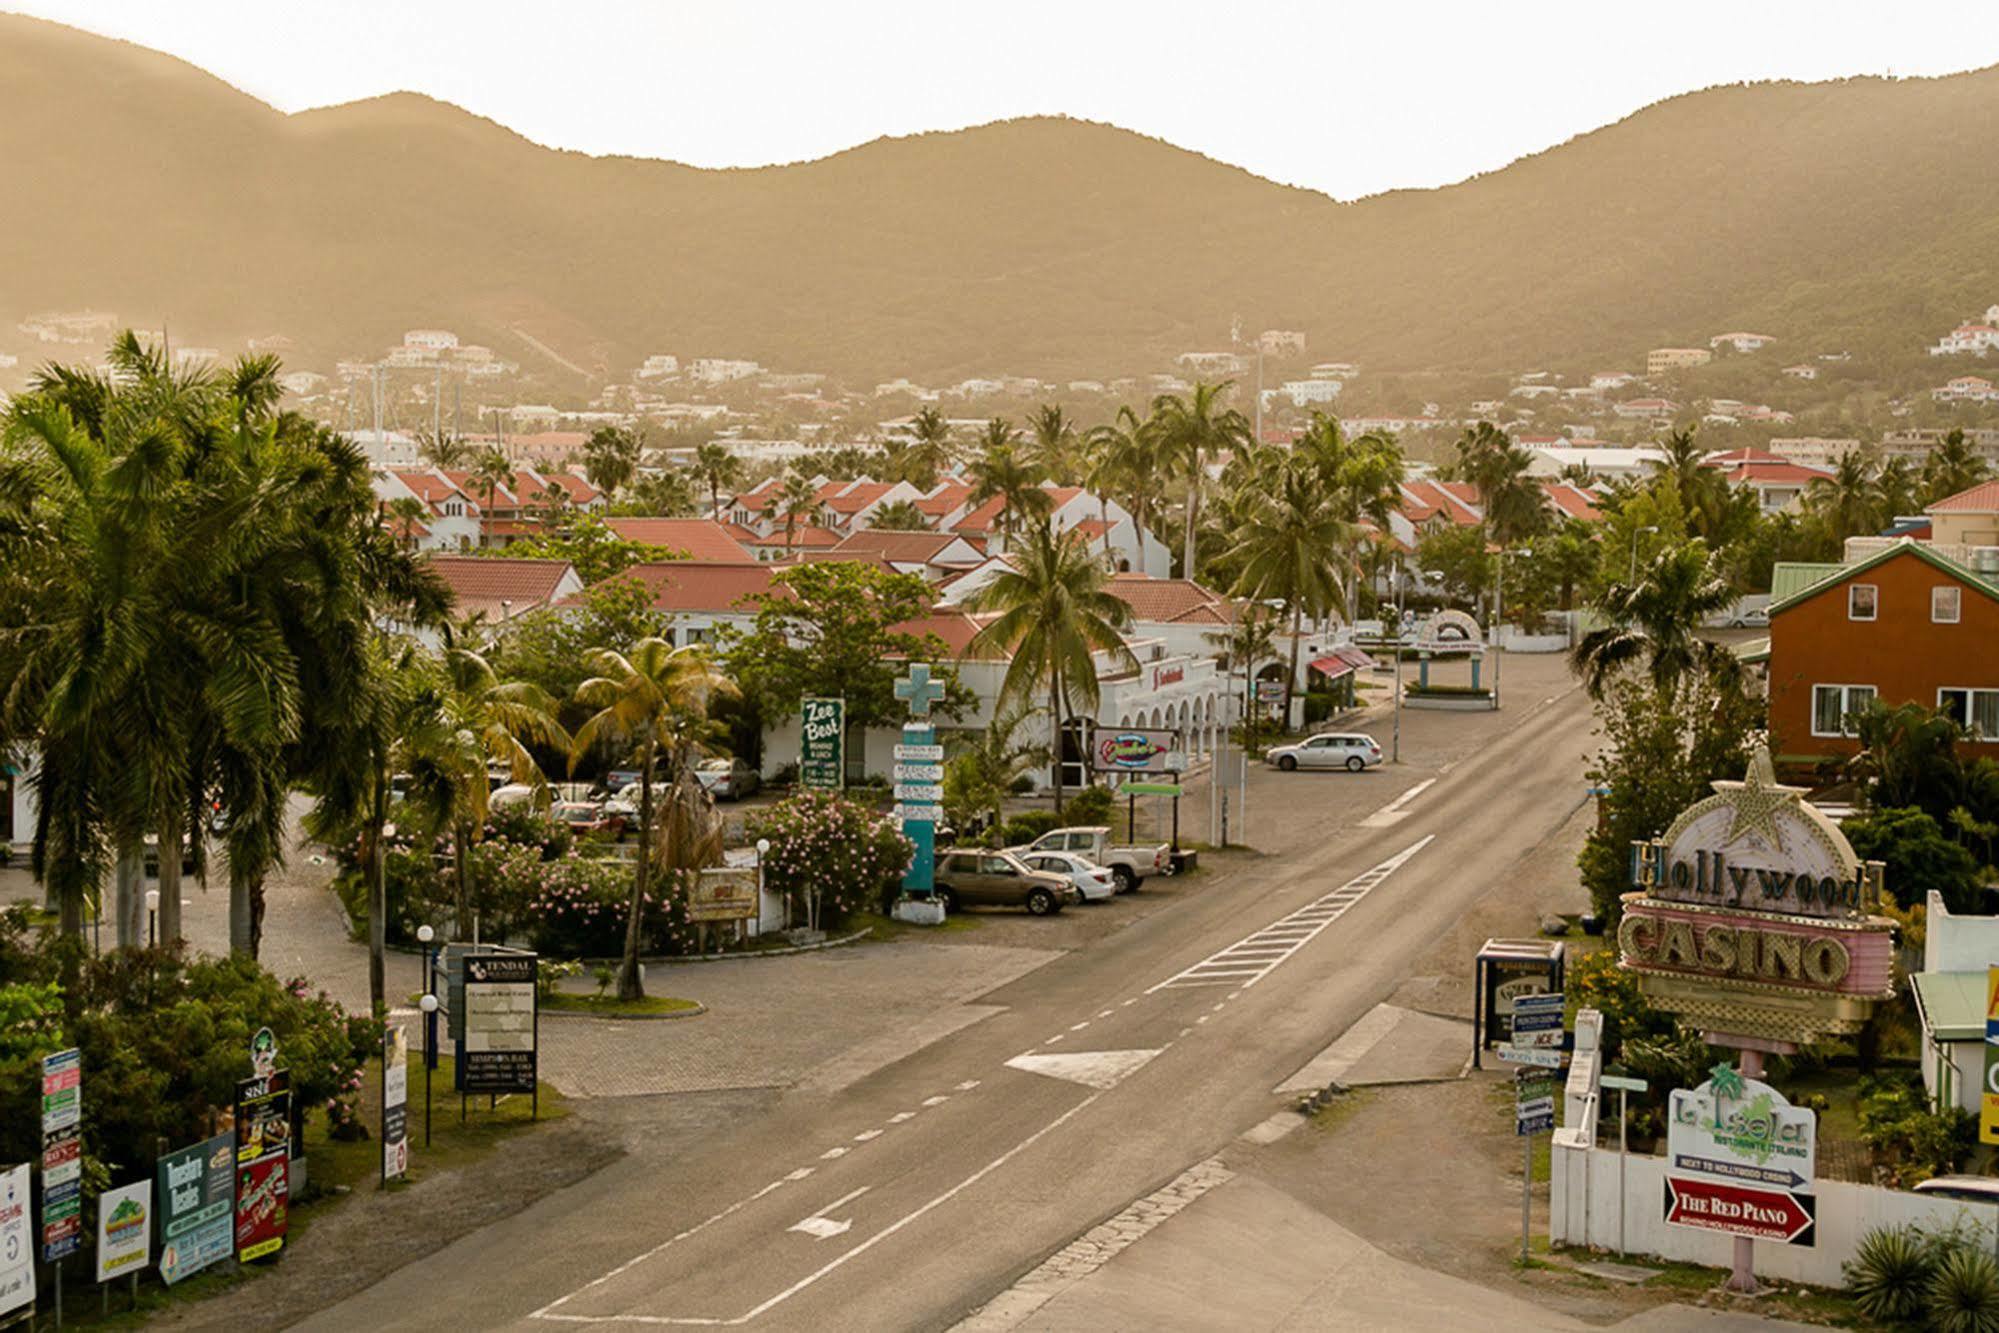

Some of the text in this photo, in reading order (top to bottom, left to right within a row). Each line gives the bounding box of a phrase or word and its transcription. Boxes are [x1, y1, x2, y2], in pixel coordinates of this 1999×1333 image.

[806, 702, 835, 722] Zee
[804, 718, 840, 741] Best
[1629, 839, 1864, 909] Hollywood
[1618, 913, 1851, 986] CASINO
[1680, 1158, 1792, 1184] NEXT TO HOLLYWOOD CASINO
[1679, 1192, 1788, 1226] THE RED PIANO
